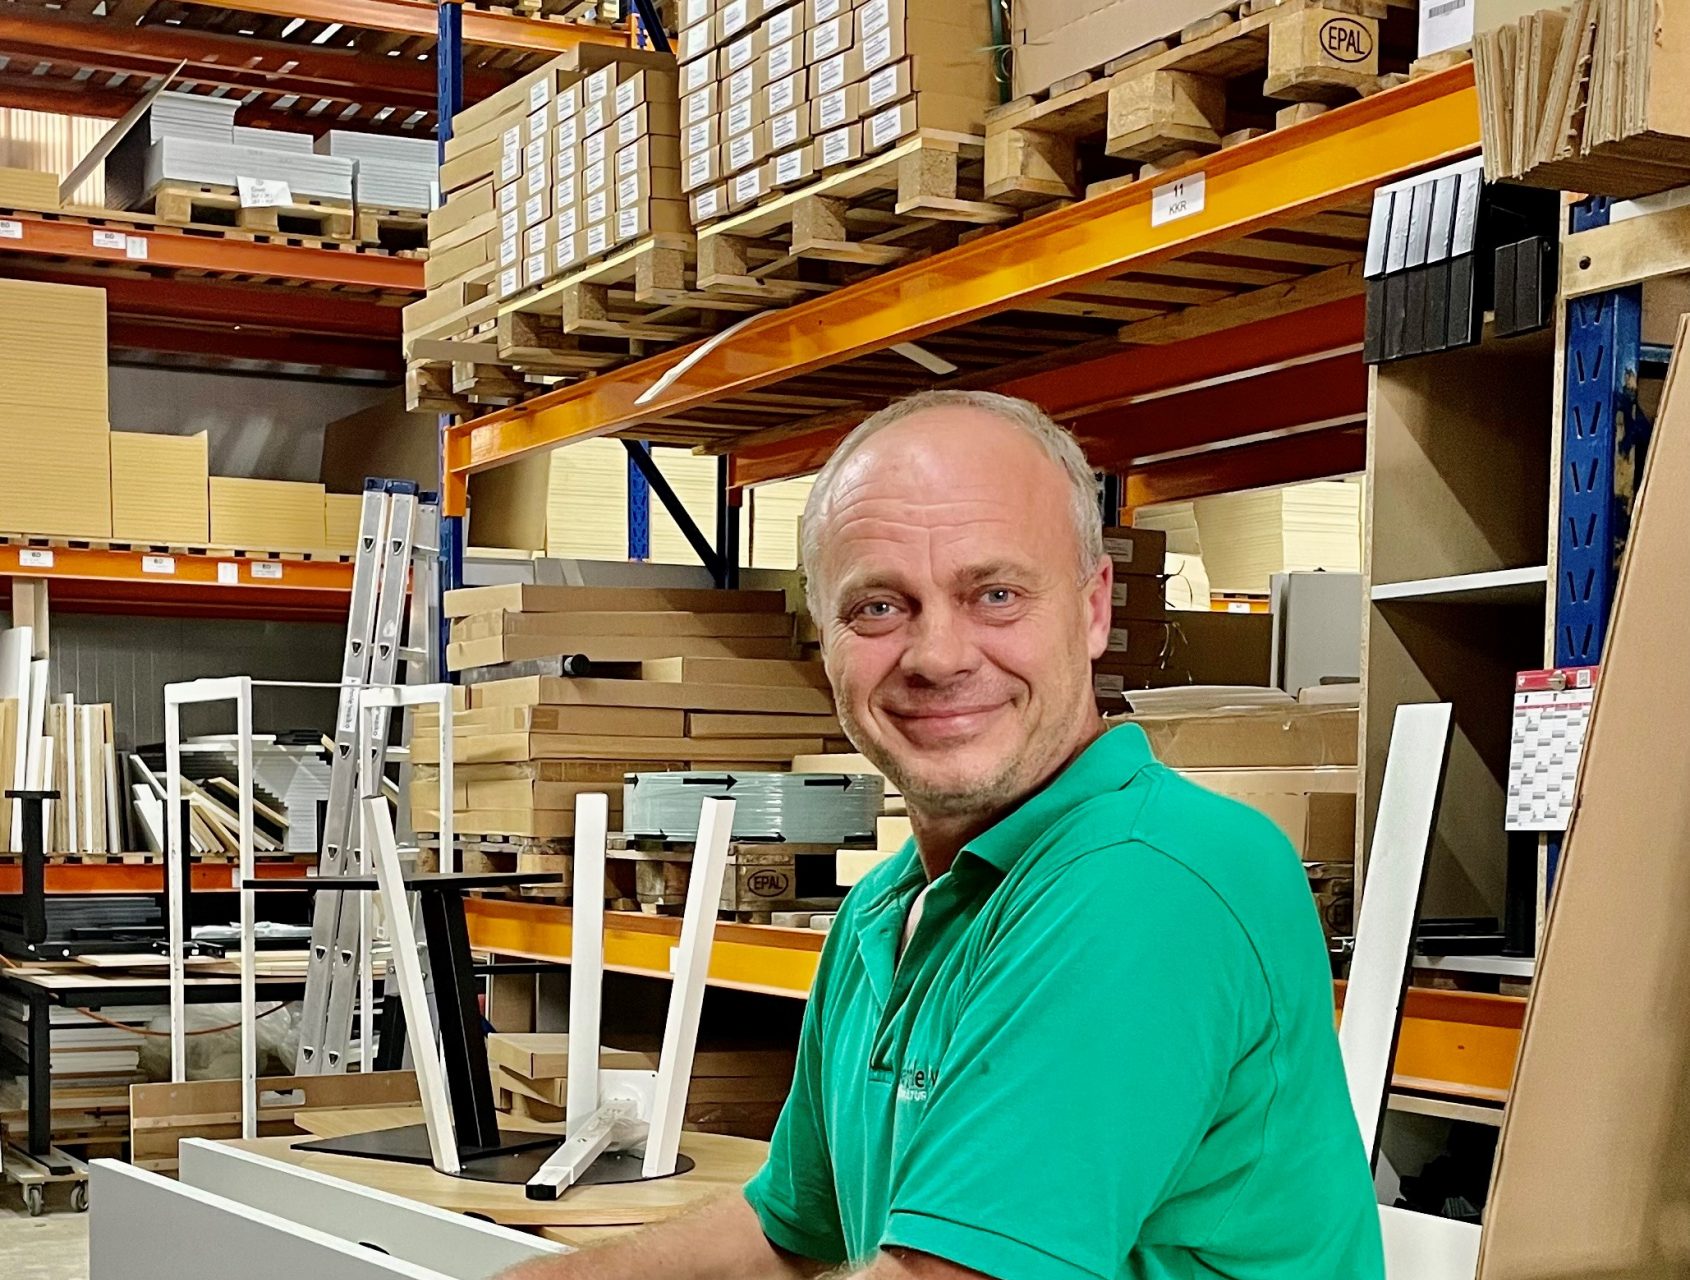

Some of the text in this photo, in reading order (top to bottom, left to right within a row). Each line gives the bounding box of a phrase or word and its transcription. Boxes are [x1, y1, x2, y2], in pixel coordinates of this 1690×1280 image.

[1328, 26, 1366, 55] EPAL
[1173, 183, 1184, 198] 11
[1169, 200, 1188, 216] KKR
[754, 876, 783, 889] EPAL
